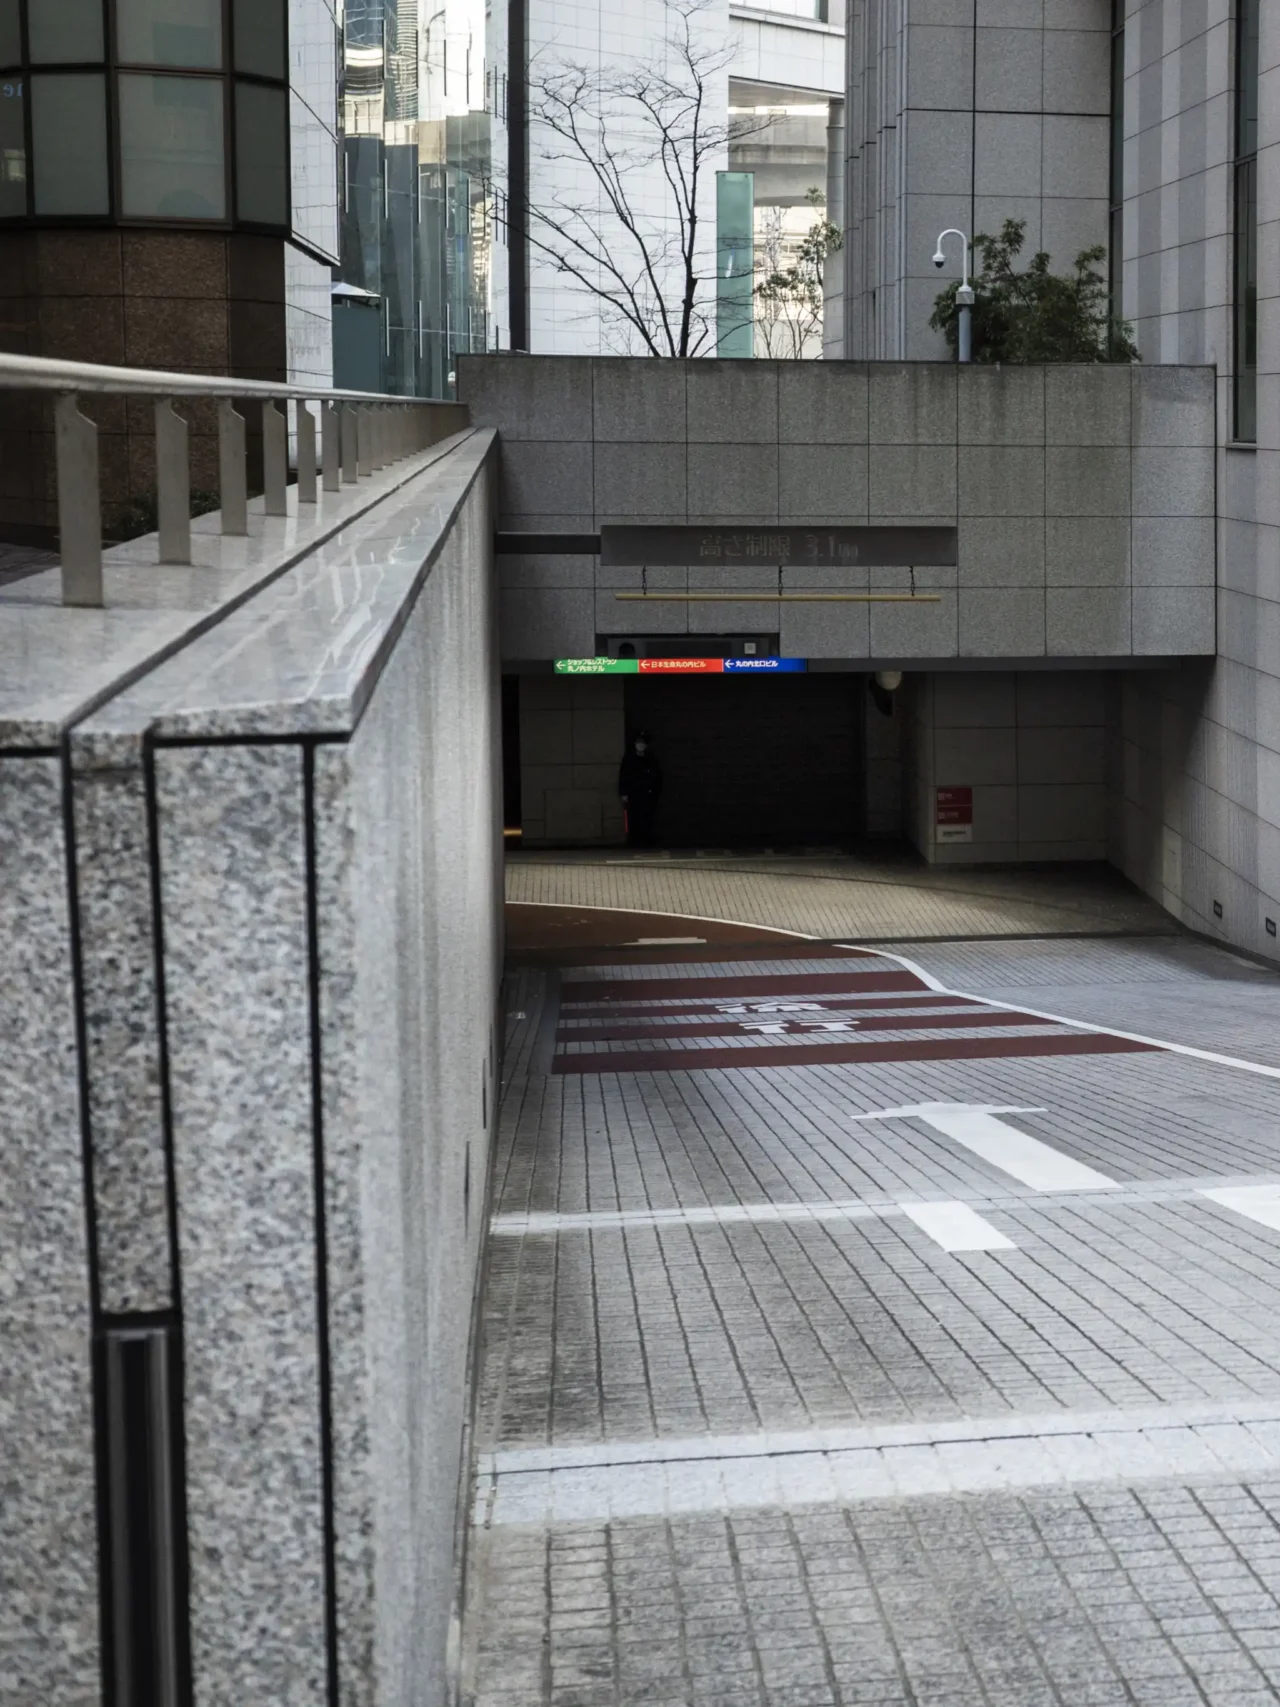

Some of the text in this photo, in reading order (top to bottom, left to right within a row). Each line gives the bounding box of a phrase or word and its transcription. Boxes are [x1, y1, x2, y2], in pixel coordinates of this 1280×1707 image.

[699, 534, 791, 557] 高さ制限
[651, 660, 707, 668] 日本生命丸の内ビル
[736, 660, 779, 668] 丸の内北口ビル
[567, 665, 605, 673] 丸ノ内ホテル
